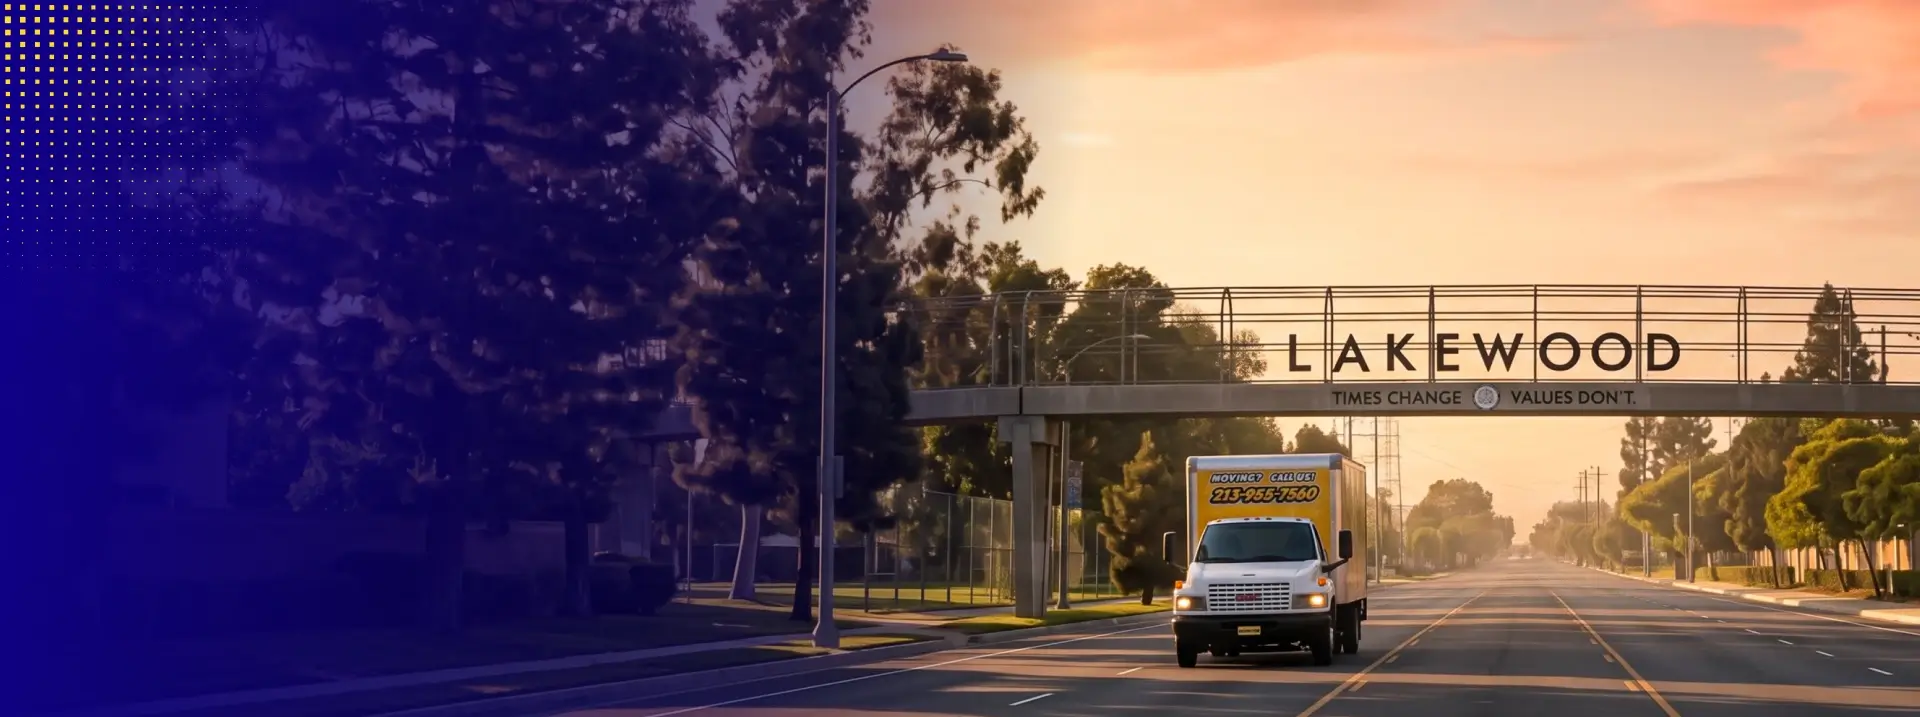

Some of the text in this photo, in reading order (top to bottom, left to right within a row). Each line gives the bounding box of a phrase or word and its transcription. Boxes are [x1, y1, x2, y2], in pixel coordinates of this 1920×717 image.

[1288, 332, 1681, 372] LAKEWOOD
[1332, 391, 1462, 405] TIMES CHANGE
[1511, 390, 1636, 405] VALUES DON'T.
[1210, 471, 1316, 483] MOVING? CALL US!
[1210, 485, 1320, 504] 213-955-7560
